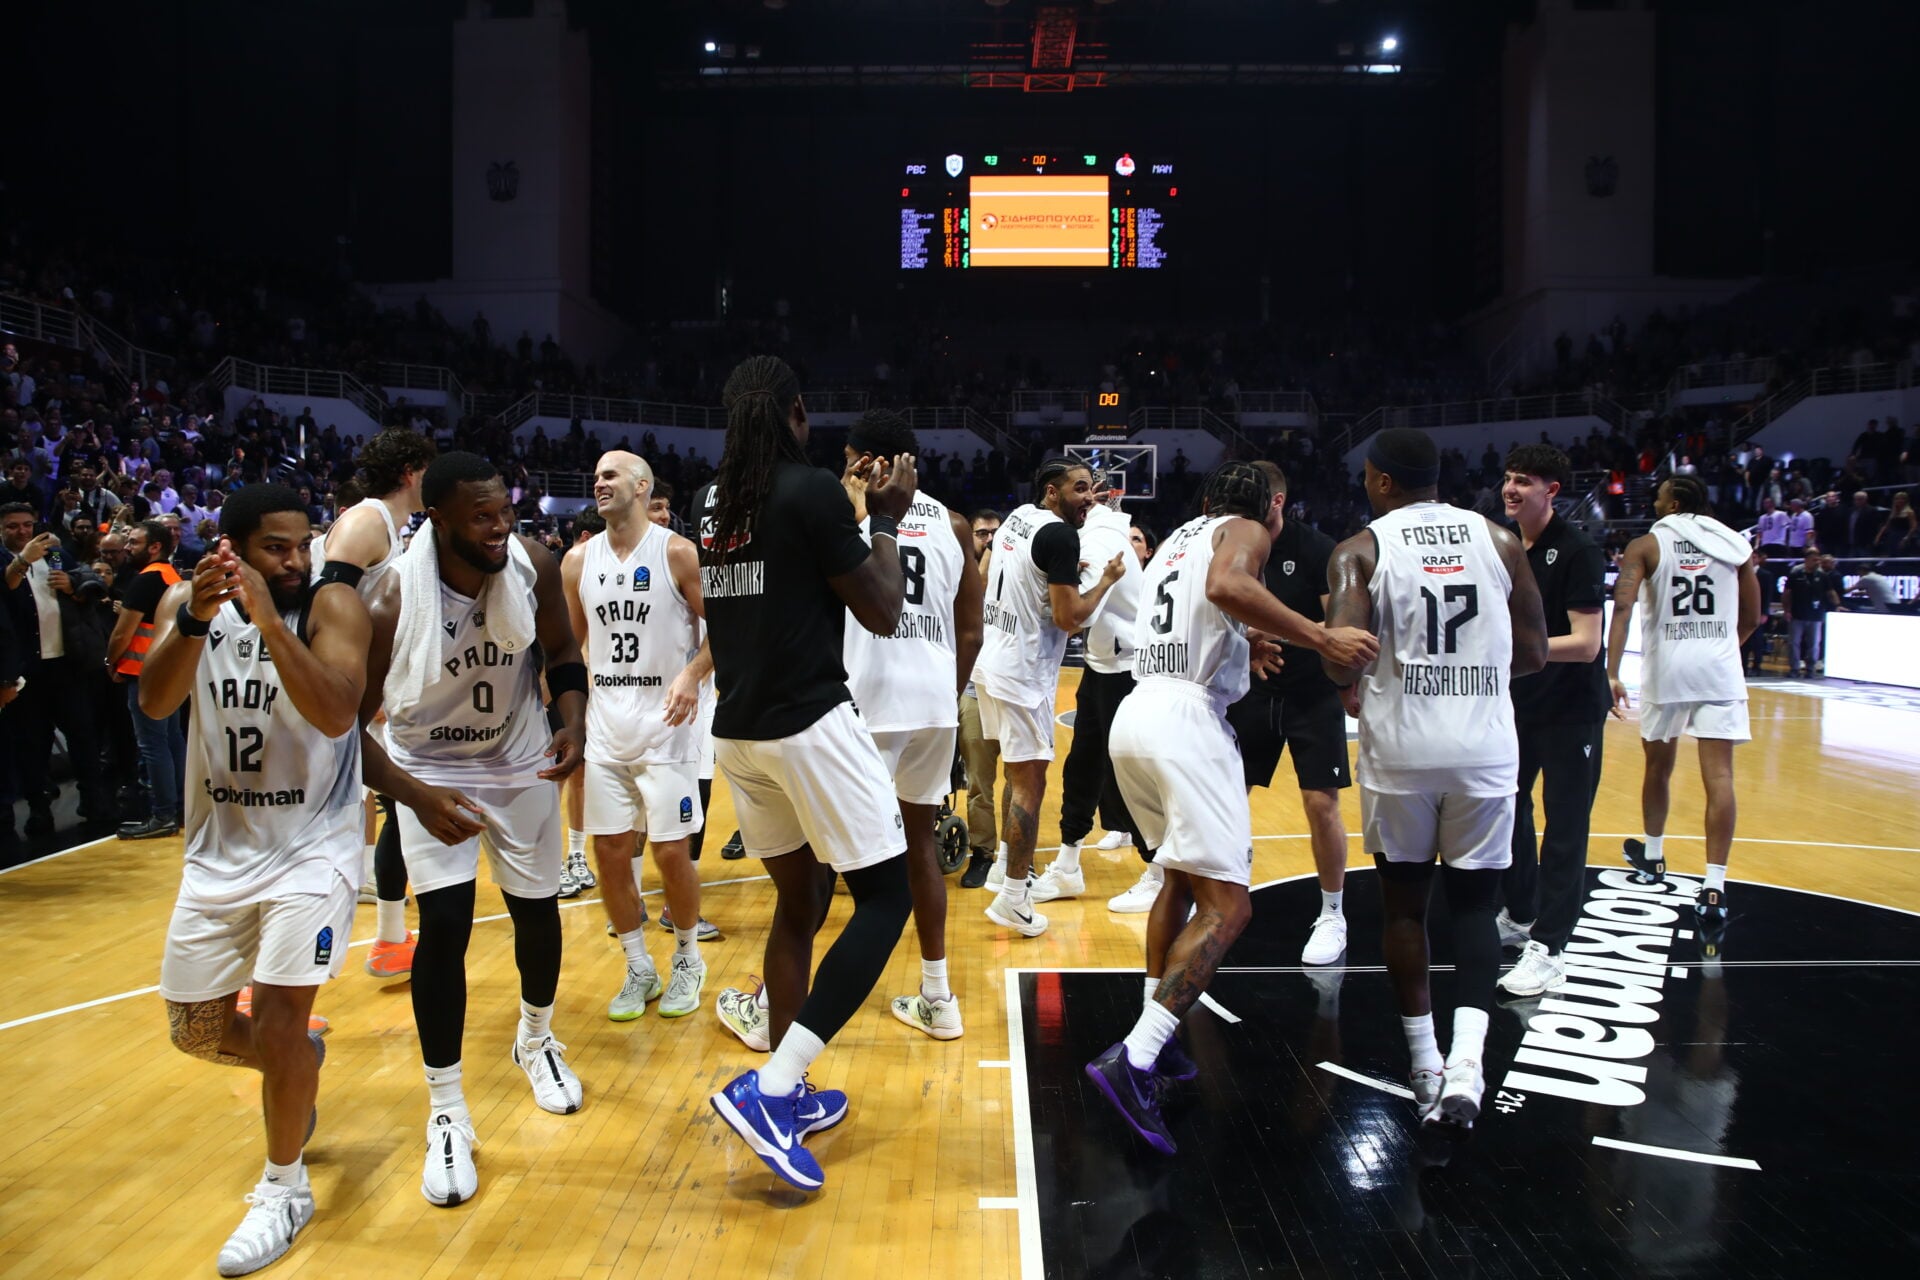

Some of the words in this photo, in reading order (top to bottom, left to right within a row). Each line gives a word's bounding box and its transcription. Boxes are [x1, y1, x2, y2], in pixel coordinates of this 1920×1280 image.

[984, 155, 998, 165] 93
[1083, 155, 1096, 165] 78
[1152, 164, 1173, 174] MAN
[906, 165, 926, 175] PBC
[1036, 166, 1043, 174] 4
[902, 188, 909, 197] 0
[1170, 187, 1177, 196] 0
[1000, 215, 1095, 223] ΣΙΔΗΡΟΠΟΥΛΟΣ
[908, 502, 941, 520] NDER
[1401, 524, 1471, 545] FOSTER
[1422, 555, 1463, 566] KRAFT
[1150, 570, 1180, 635] 5
[1671, 574, 1715, 616] 26
[595, 600, 651, 626] PAOK
[1420, 584, 1479, 655] 17
[1664, 621, 1728, 640] THESSALONIKI
[611, 633, 639, 663] 33
[594, 674, 662, 687] Stoiximan
[473, 681, 494, 713] 0
[225, 726, 263, 773] 12
[1502, 869, 1703, 1107] Stoiximan
[1494, 1090, 1527, 1114] 21+
